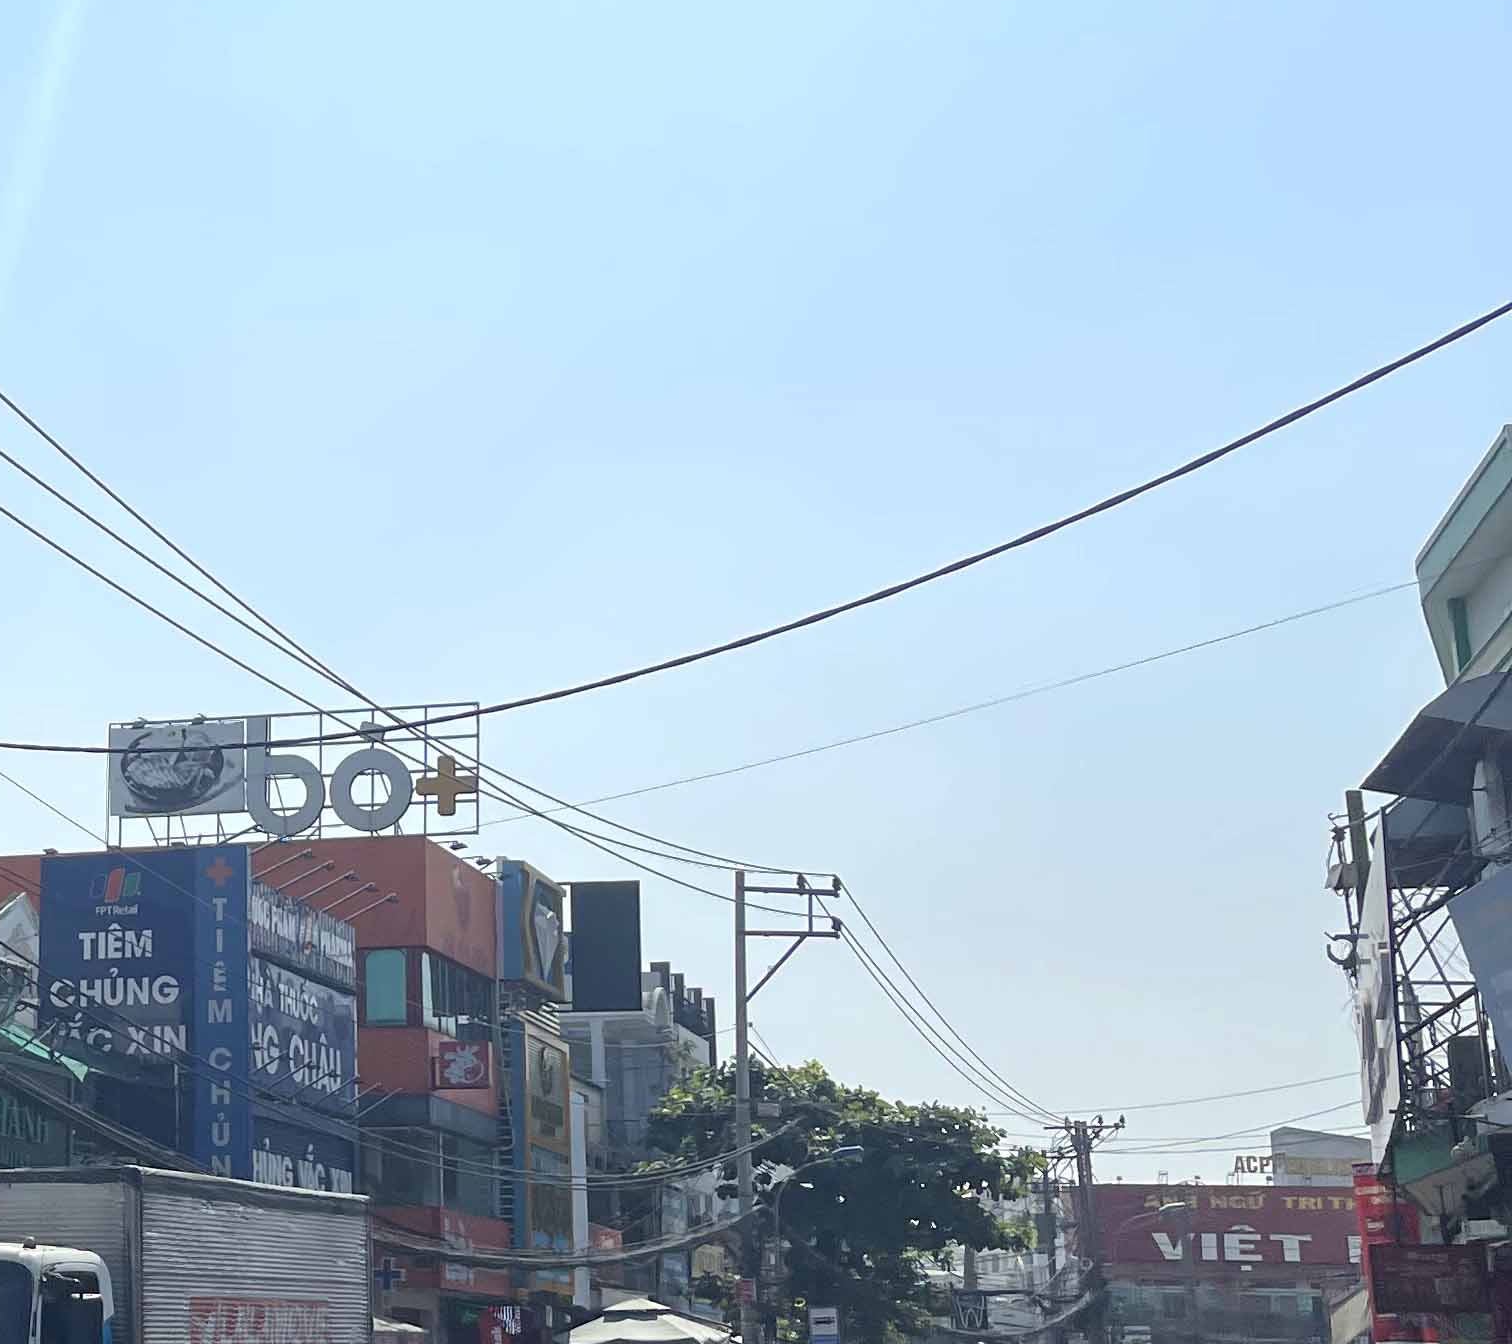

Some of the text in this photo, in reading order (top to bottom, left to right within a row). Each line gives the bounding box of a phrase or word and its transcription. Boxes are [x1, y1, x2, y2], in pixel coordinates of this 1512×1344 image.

[96, 904, 138, 916] FPT Retail
[79, 923, 153, 960] TIÊM
[208, 897, 232, 1024] TIÊM
[50, 968, 180, 1007] CHỦNG
[278, 979, 319, 1025] THUỐC
[126, 1025, 187, 1055] XIN
[289, 1033, 342, 1096] CHÂU
[1280, 1196, 1322, 1210] TRI
[1152, 1224, 1313, 1272] VIỆT
